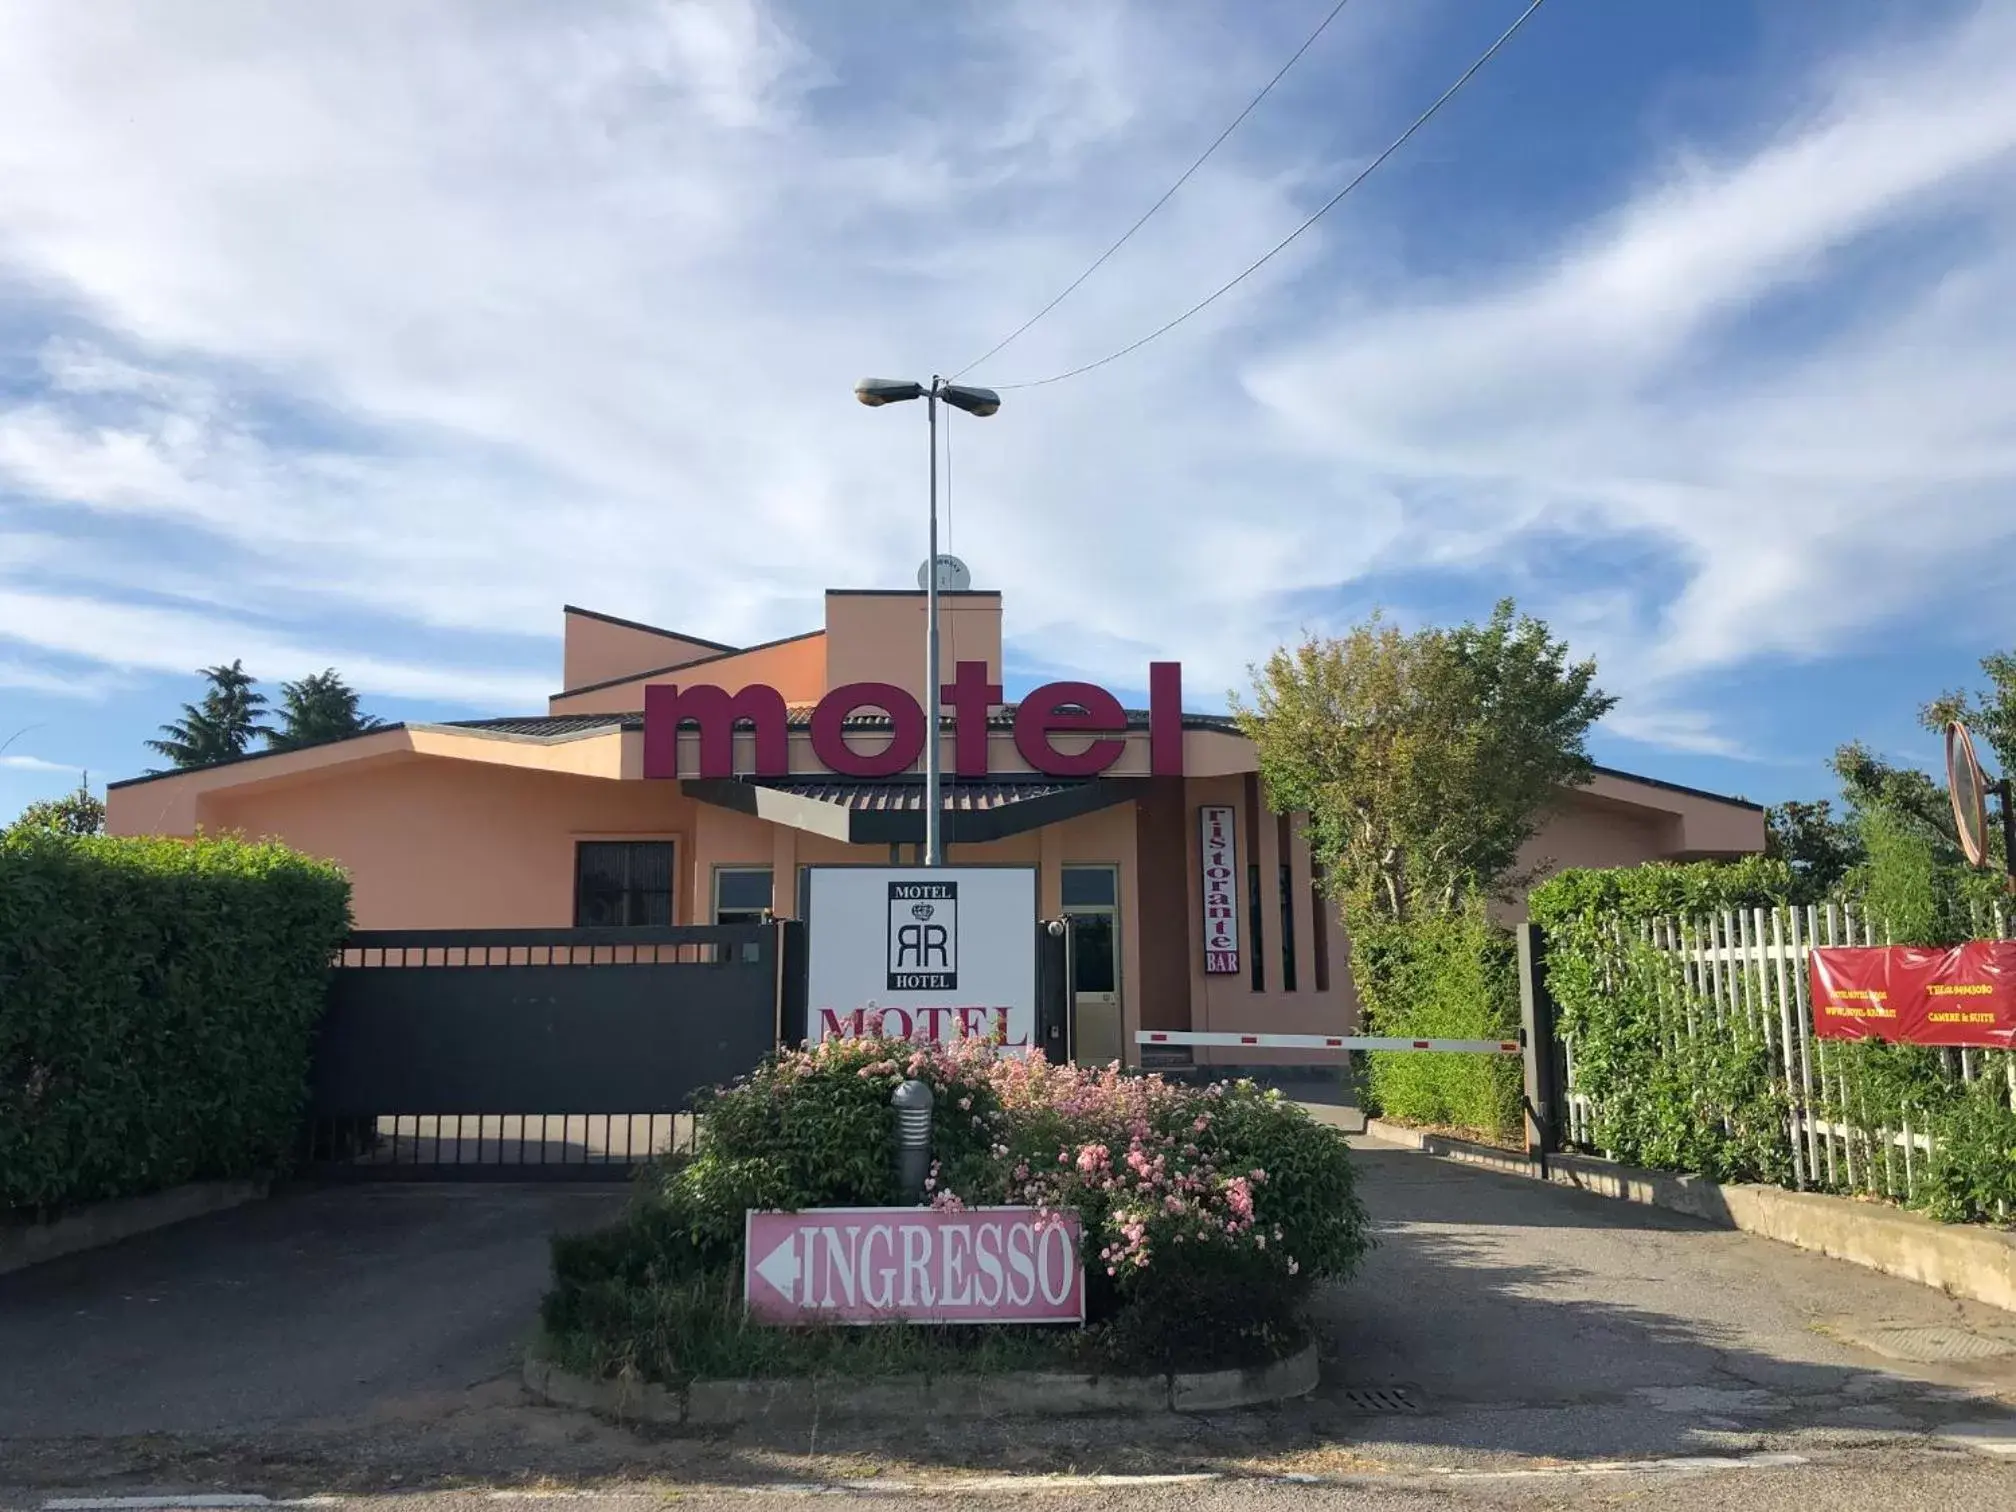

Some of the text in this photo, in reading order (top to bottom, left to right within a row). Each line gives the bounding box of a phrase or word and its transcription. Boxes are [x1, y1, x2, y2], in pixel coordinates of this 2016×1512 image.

[643, 661, 1182, 778] motel
[895, 886, 951, 899] MOTEL
[1206, 810, 1232, 949] ristorante
[897, 975, 950, 989] HOTEL
[1206, 952, 1238, 972] BAR
[817, 1006, 1028, 1048] MOTEL
[800, 1222, 1074, 1309] INGRESSO
